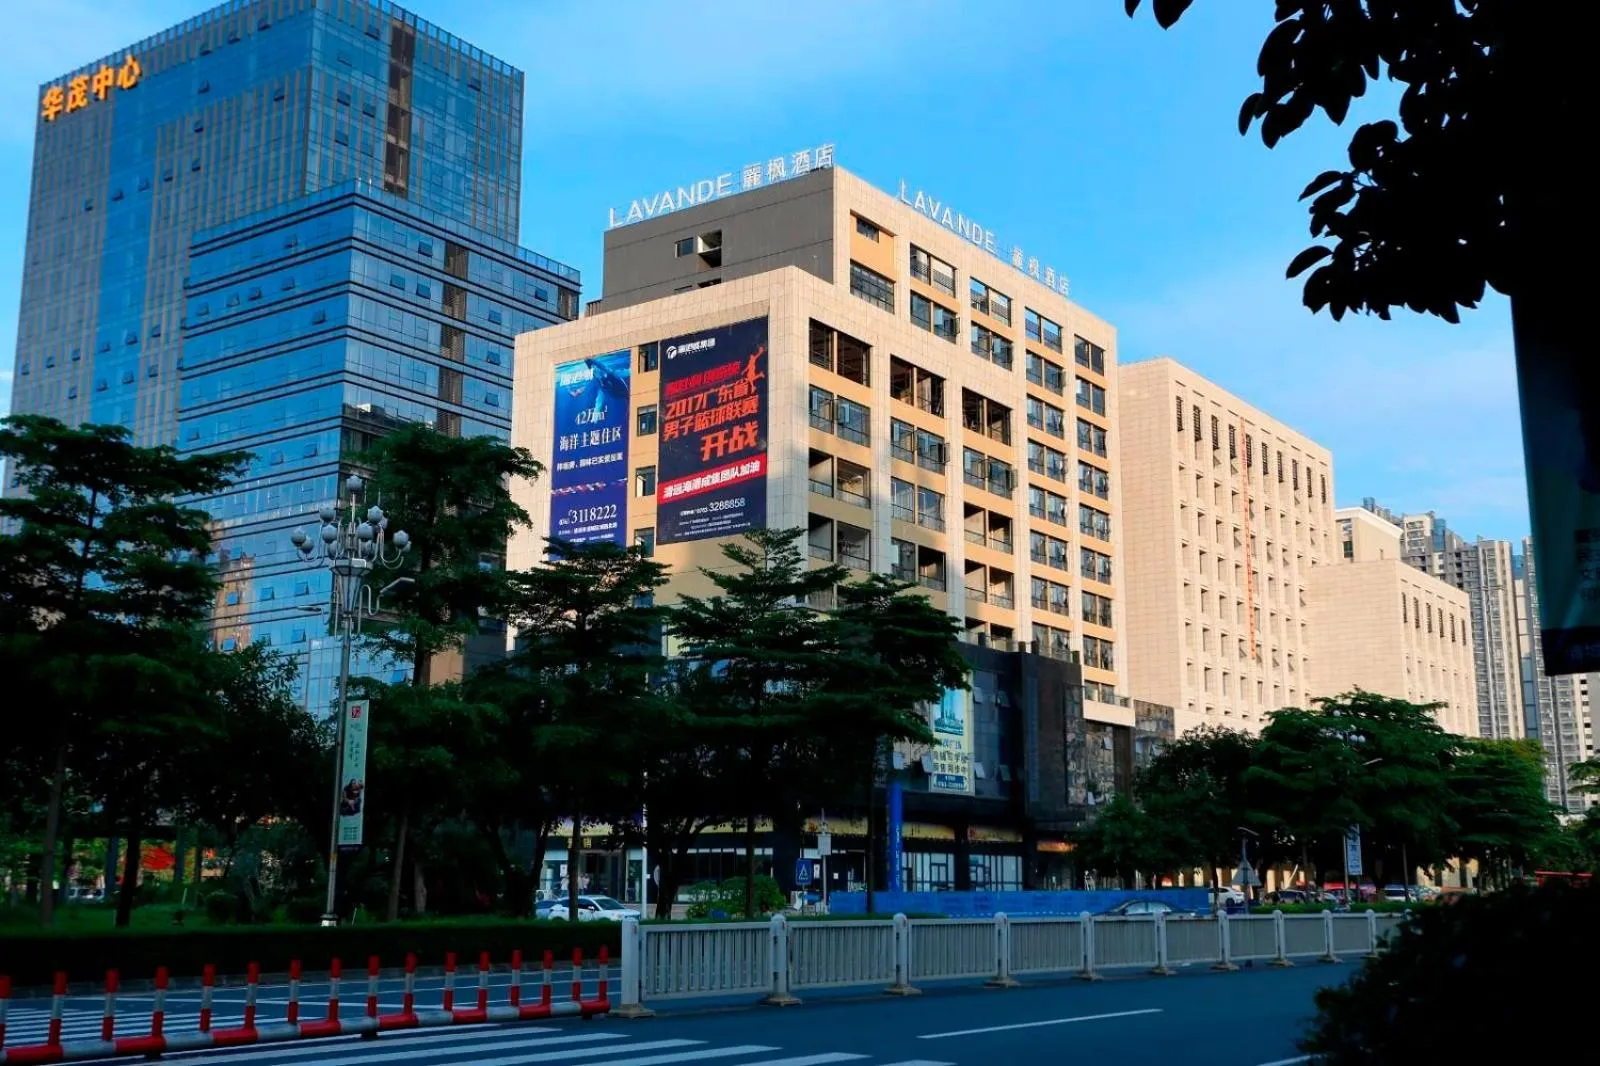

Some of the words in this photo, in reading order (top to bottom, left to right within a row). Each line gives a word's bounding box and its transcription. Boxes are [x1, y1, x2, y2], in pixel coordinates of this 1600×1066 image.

[42, 54, 142, 121] 华茂中心
[608, 171, 733, 229] LAVANDE
[899, 179, 996, 254] LAVANDE
[663, 395, 759, 441] 男子篮球联赛
[665, 378, 749, 420] 2017广东省
[559, 426, 622, 451] 海洋主题住区
[700, 421, 758, 461] 开战
[570, 504, 618, 524] 3118222
